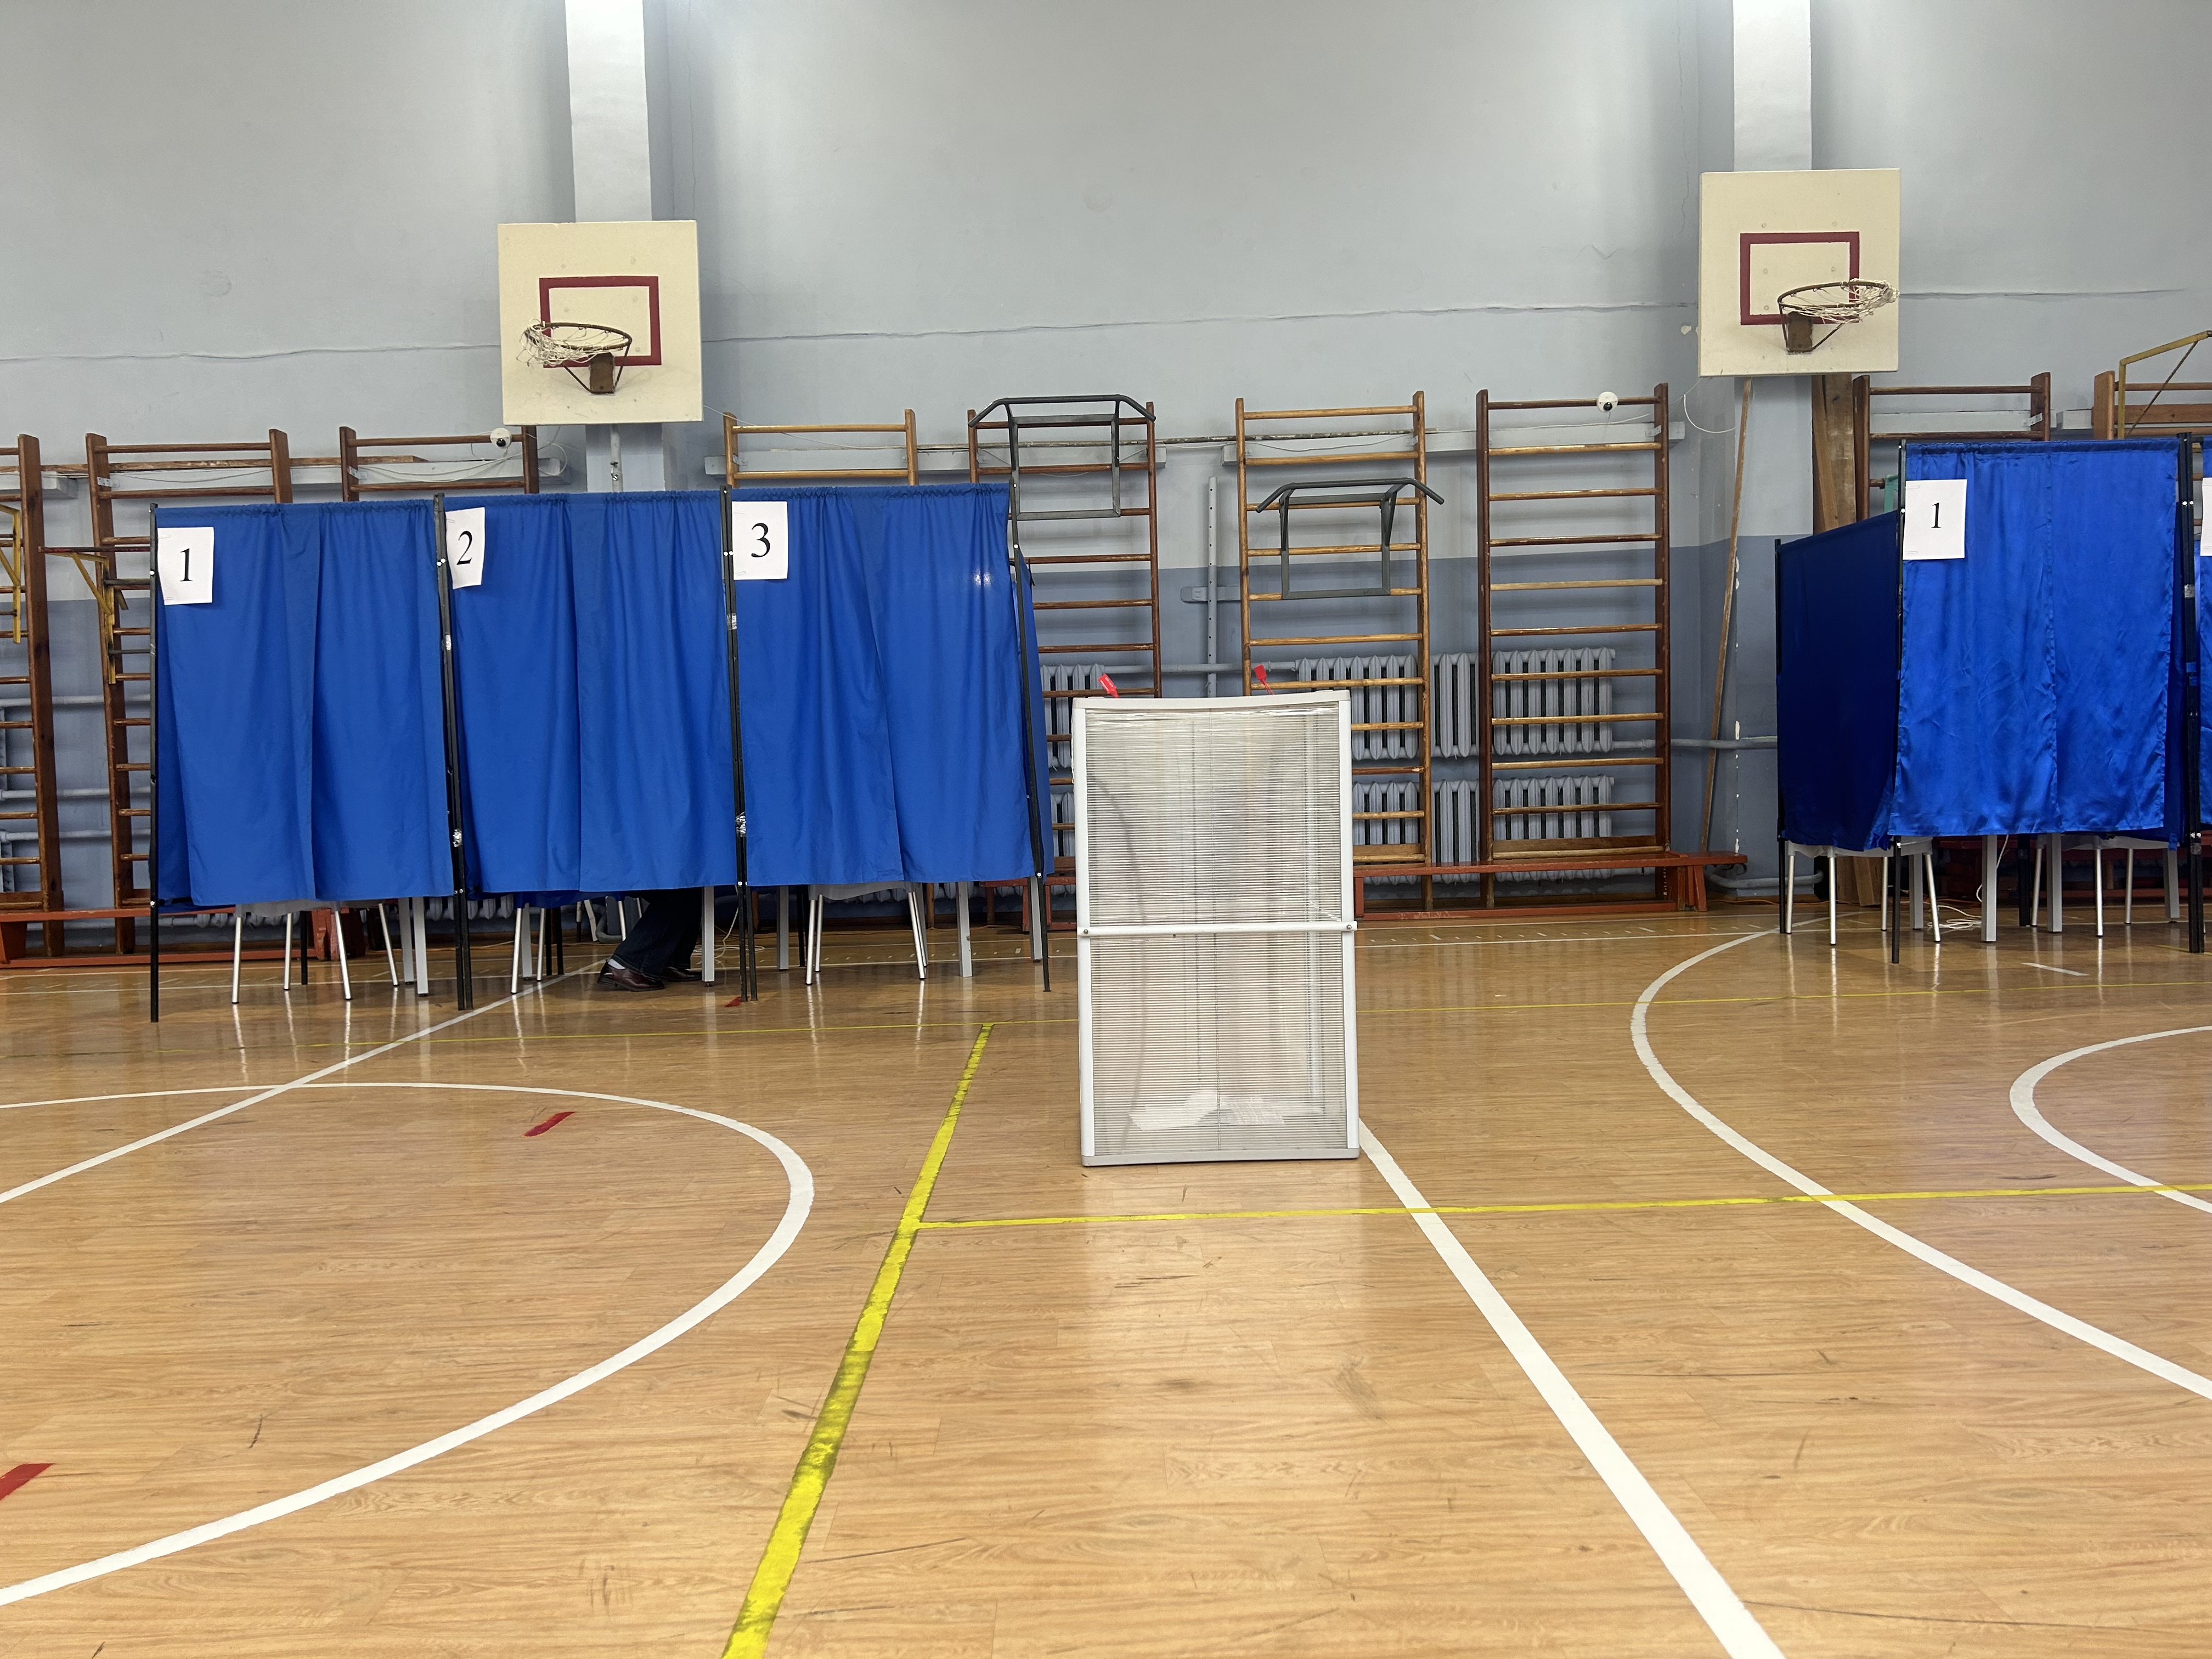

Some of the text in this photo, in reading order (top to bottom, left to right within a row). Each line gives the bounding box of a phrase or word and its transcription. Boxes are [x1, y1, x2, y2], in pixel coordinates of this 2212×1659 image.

[1931, 502, 1942, 528] 1
[456, 531, 472, 566] 2
[751, 522, 770, 558] 3
[179, 548, 193, 582] 1
